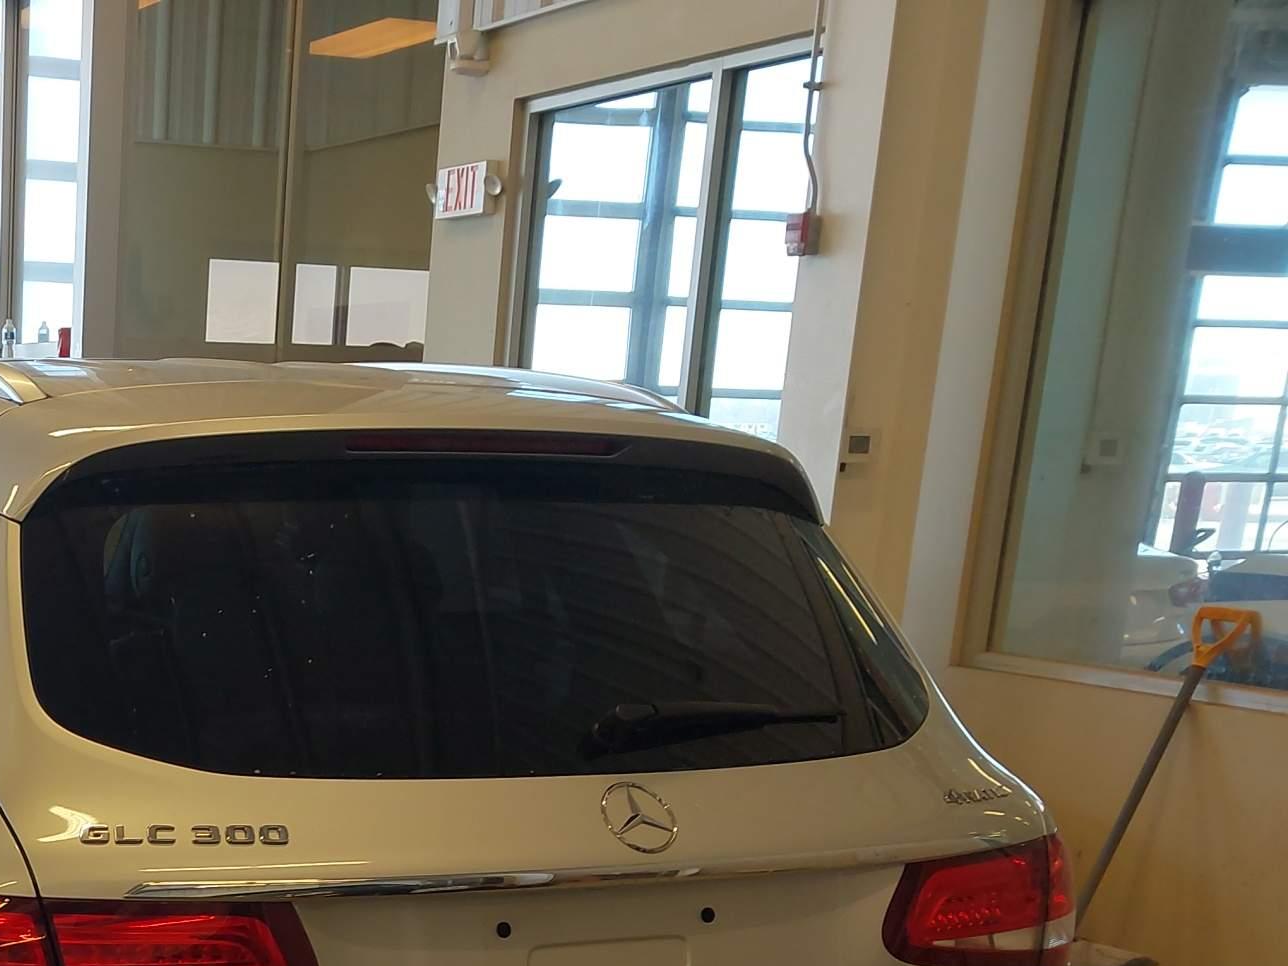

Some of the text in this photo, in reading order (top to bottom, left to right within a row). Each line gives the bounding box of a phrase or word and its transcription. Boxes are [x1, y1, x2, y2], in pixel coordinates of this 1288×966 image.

[443, 165, 479, 213] EXIT
[79, 824, 289, 845] GLC 300
